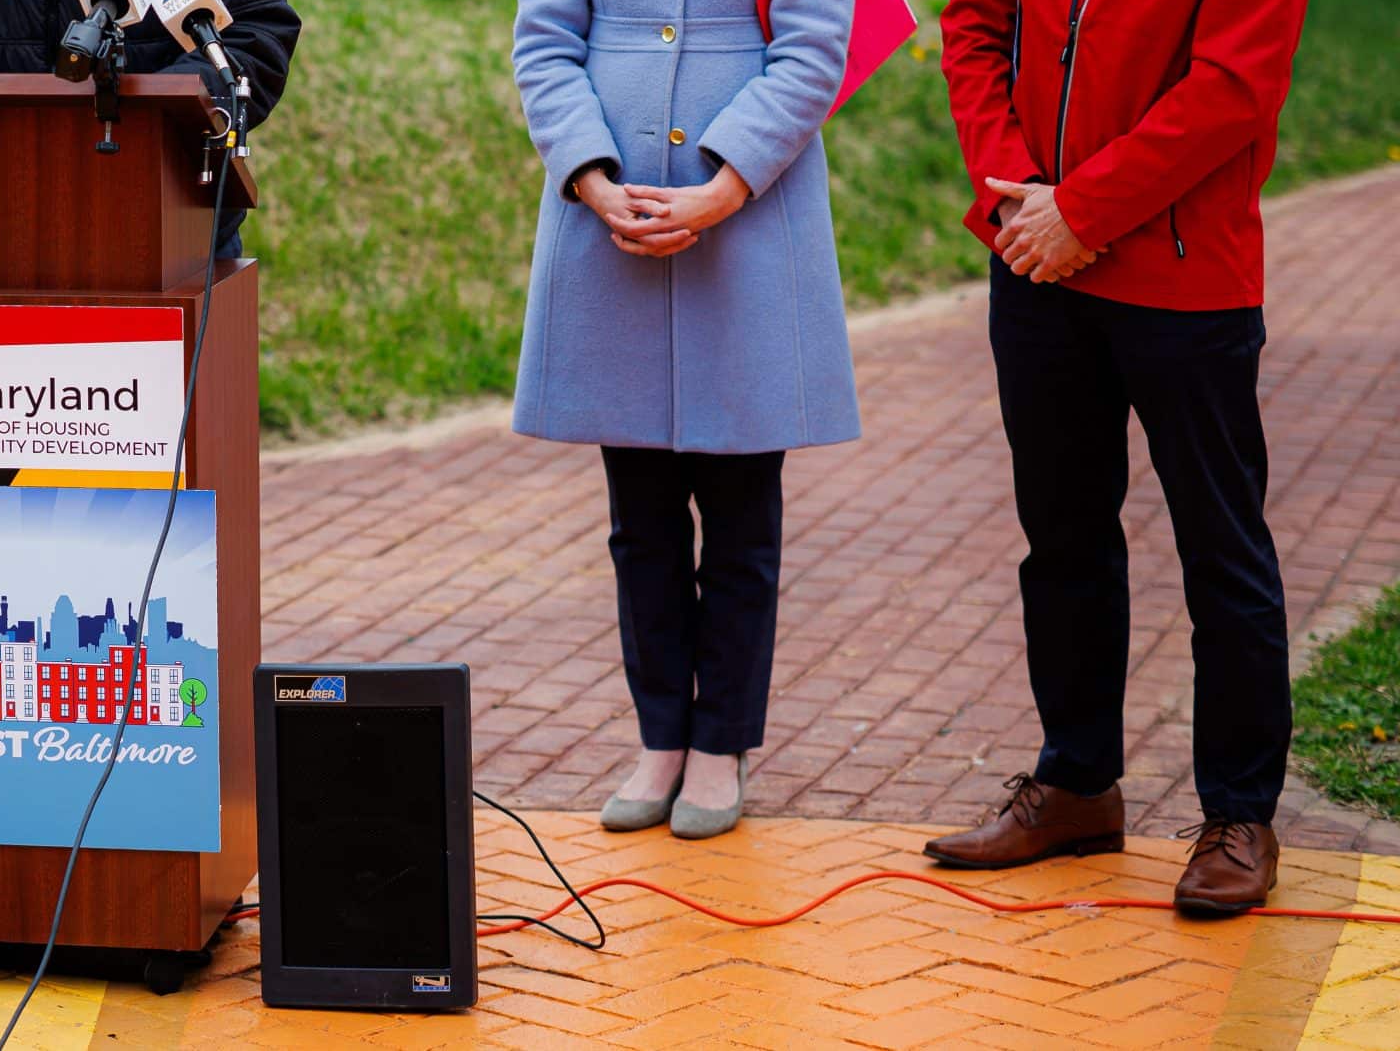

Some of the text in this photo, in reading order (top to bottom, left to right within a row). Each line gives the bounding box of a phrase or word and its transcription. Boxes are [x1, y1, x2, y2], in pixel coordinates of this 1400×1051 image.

[26, 421, 110, 436] HOUSING
[32, 440, 168, 456] DEVELOPMENT
[279, 689, 336, 699] EXPLORER
